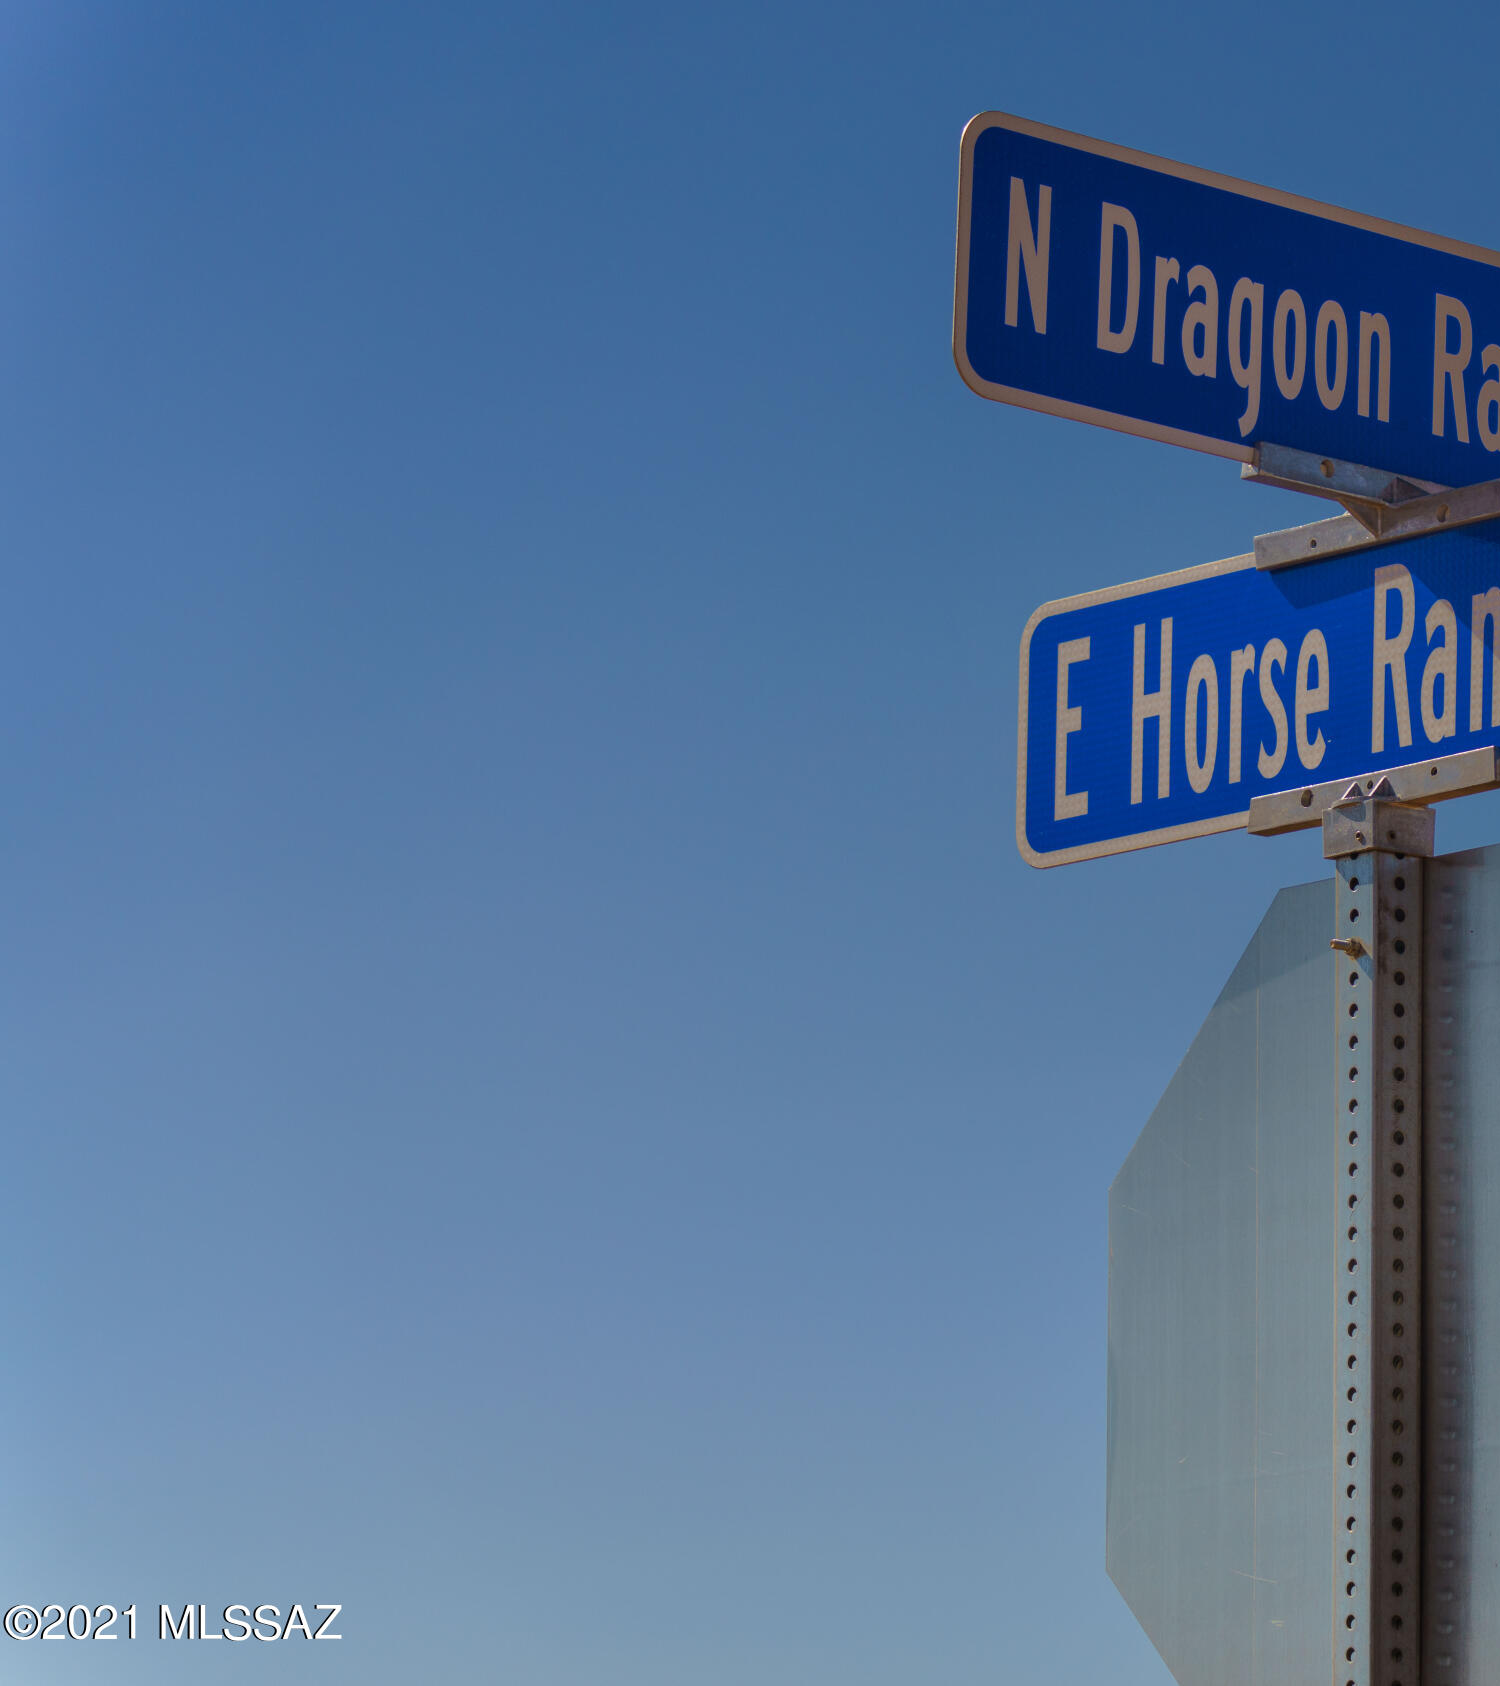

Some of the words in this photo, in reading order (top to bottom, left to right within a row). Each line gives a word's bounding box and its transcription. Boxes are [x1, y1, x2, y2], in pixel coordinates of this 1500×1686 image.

[1004, 175, 1053, 335] N
[1096, 201, 1391, 437] Dragoon
[1053, 635, 1091, 822] E
[1129, 616, 1331, 805] Horse
